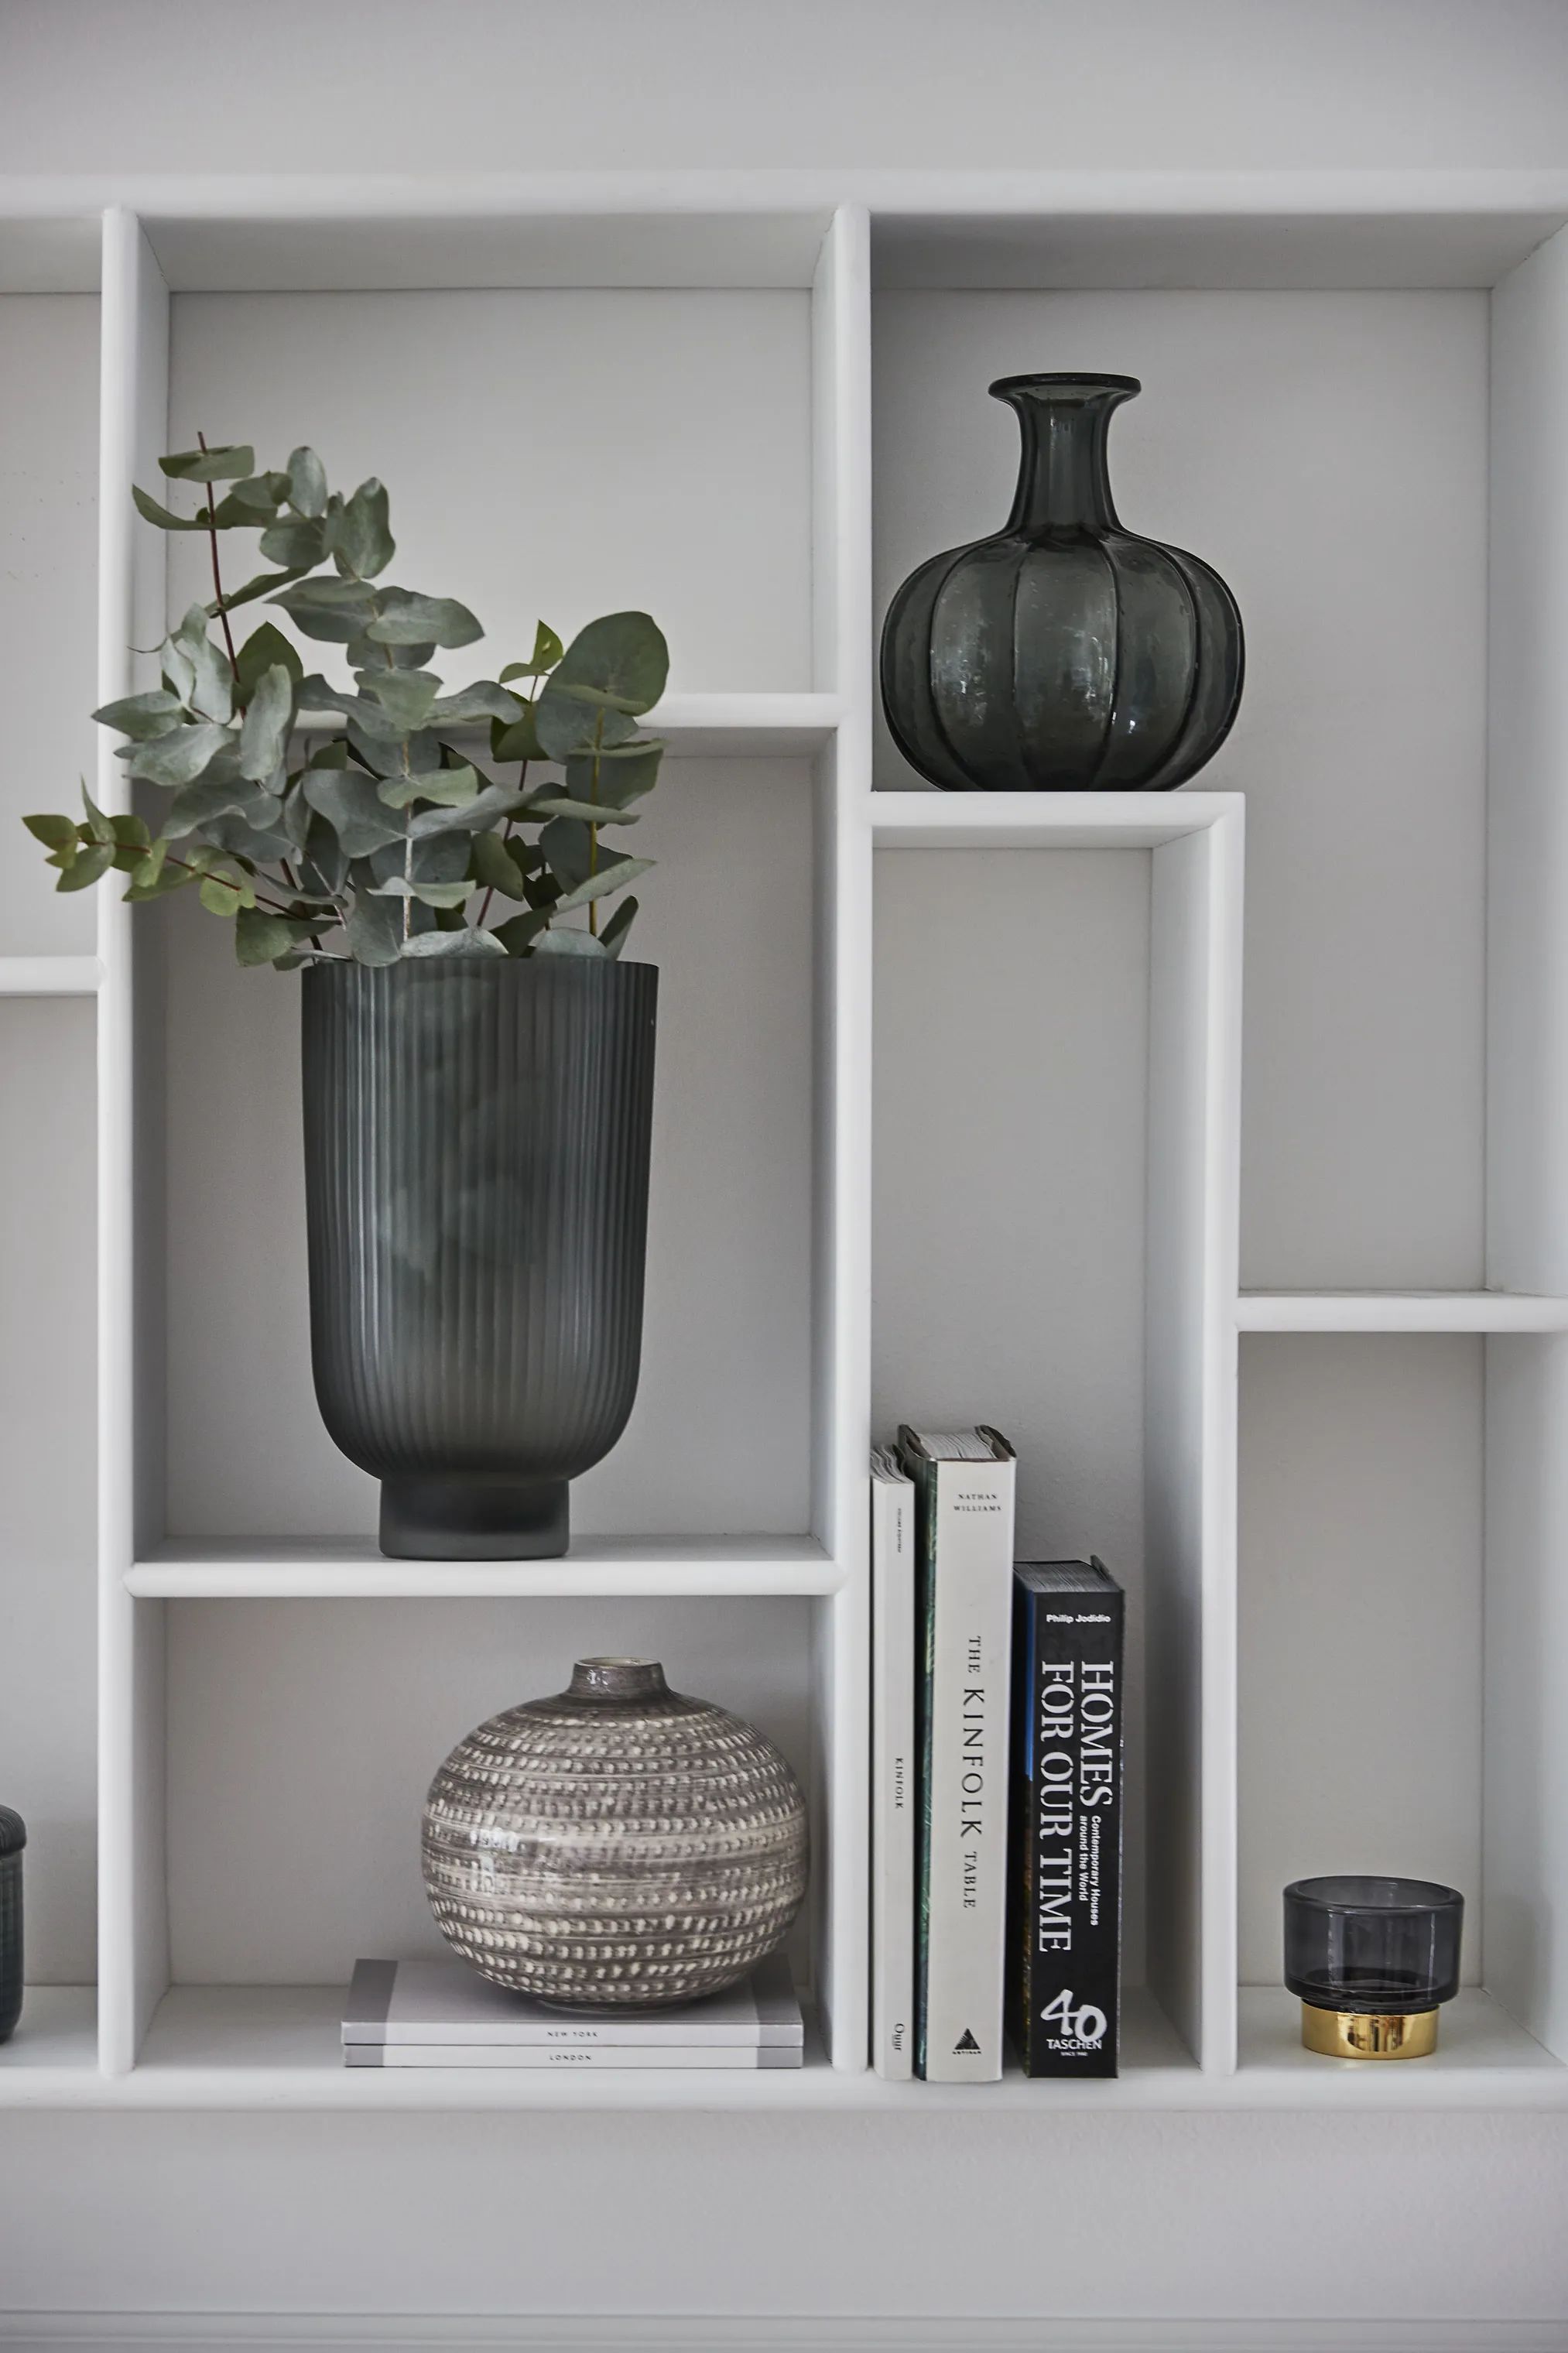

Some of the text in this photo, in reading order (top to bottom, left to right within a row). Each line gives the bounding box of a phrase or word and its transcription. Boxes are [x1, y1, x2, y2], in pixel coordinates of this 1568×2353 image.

[1046, 1614, 1111, 1624] Philip Jodidio
[960, 1635, 984, 1909] THE KINFOLK TABLE
[1079, 1660, 1114, 1807] HOMES
[895, 1758, 904, 1808] KINFOLK
[1039, 1660, 1075, 1952] FOR OUR TIME
[1078, 1815, 1089, 1901] around the World
[1089, 1815, 1102, 1926] Contemporary Houses
[1040, 1988, 1108, 2043] 40
[1046, 2039, 1102, 2050] TASCHEN
